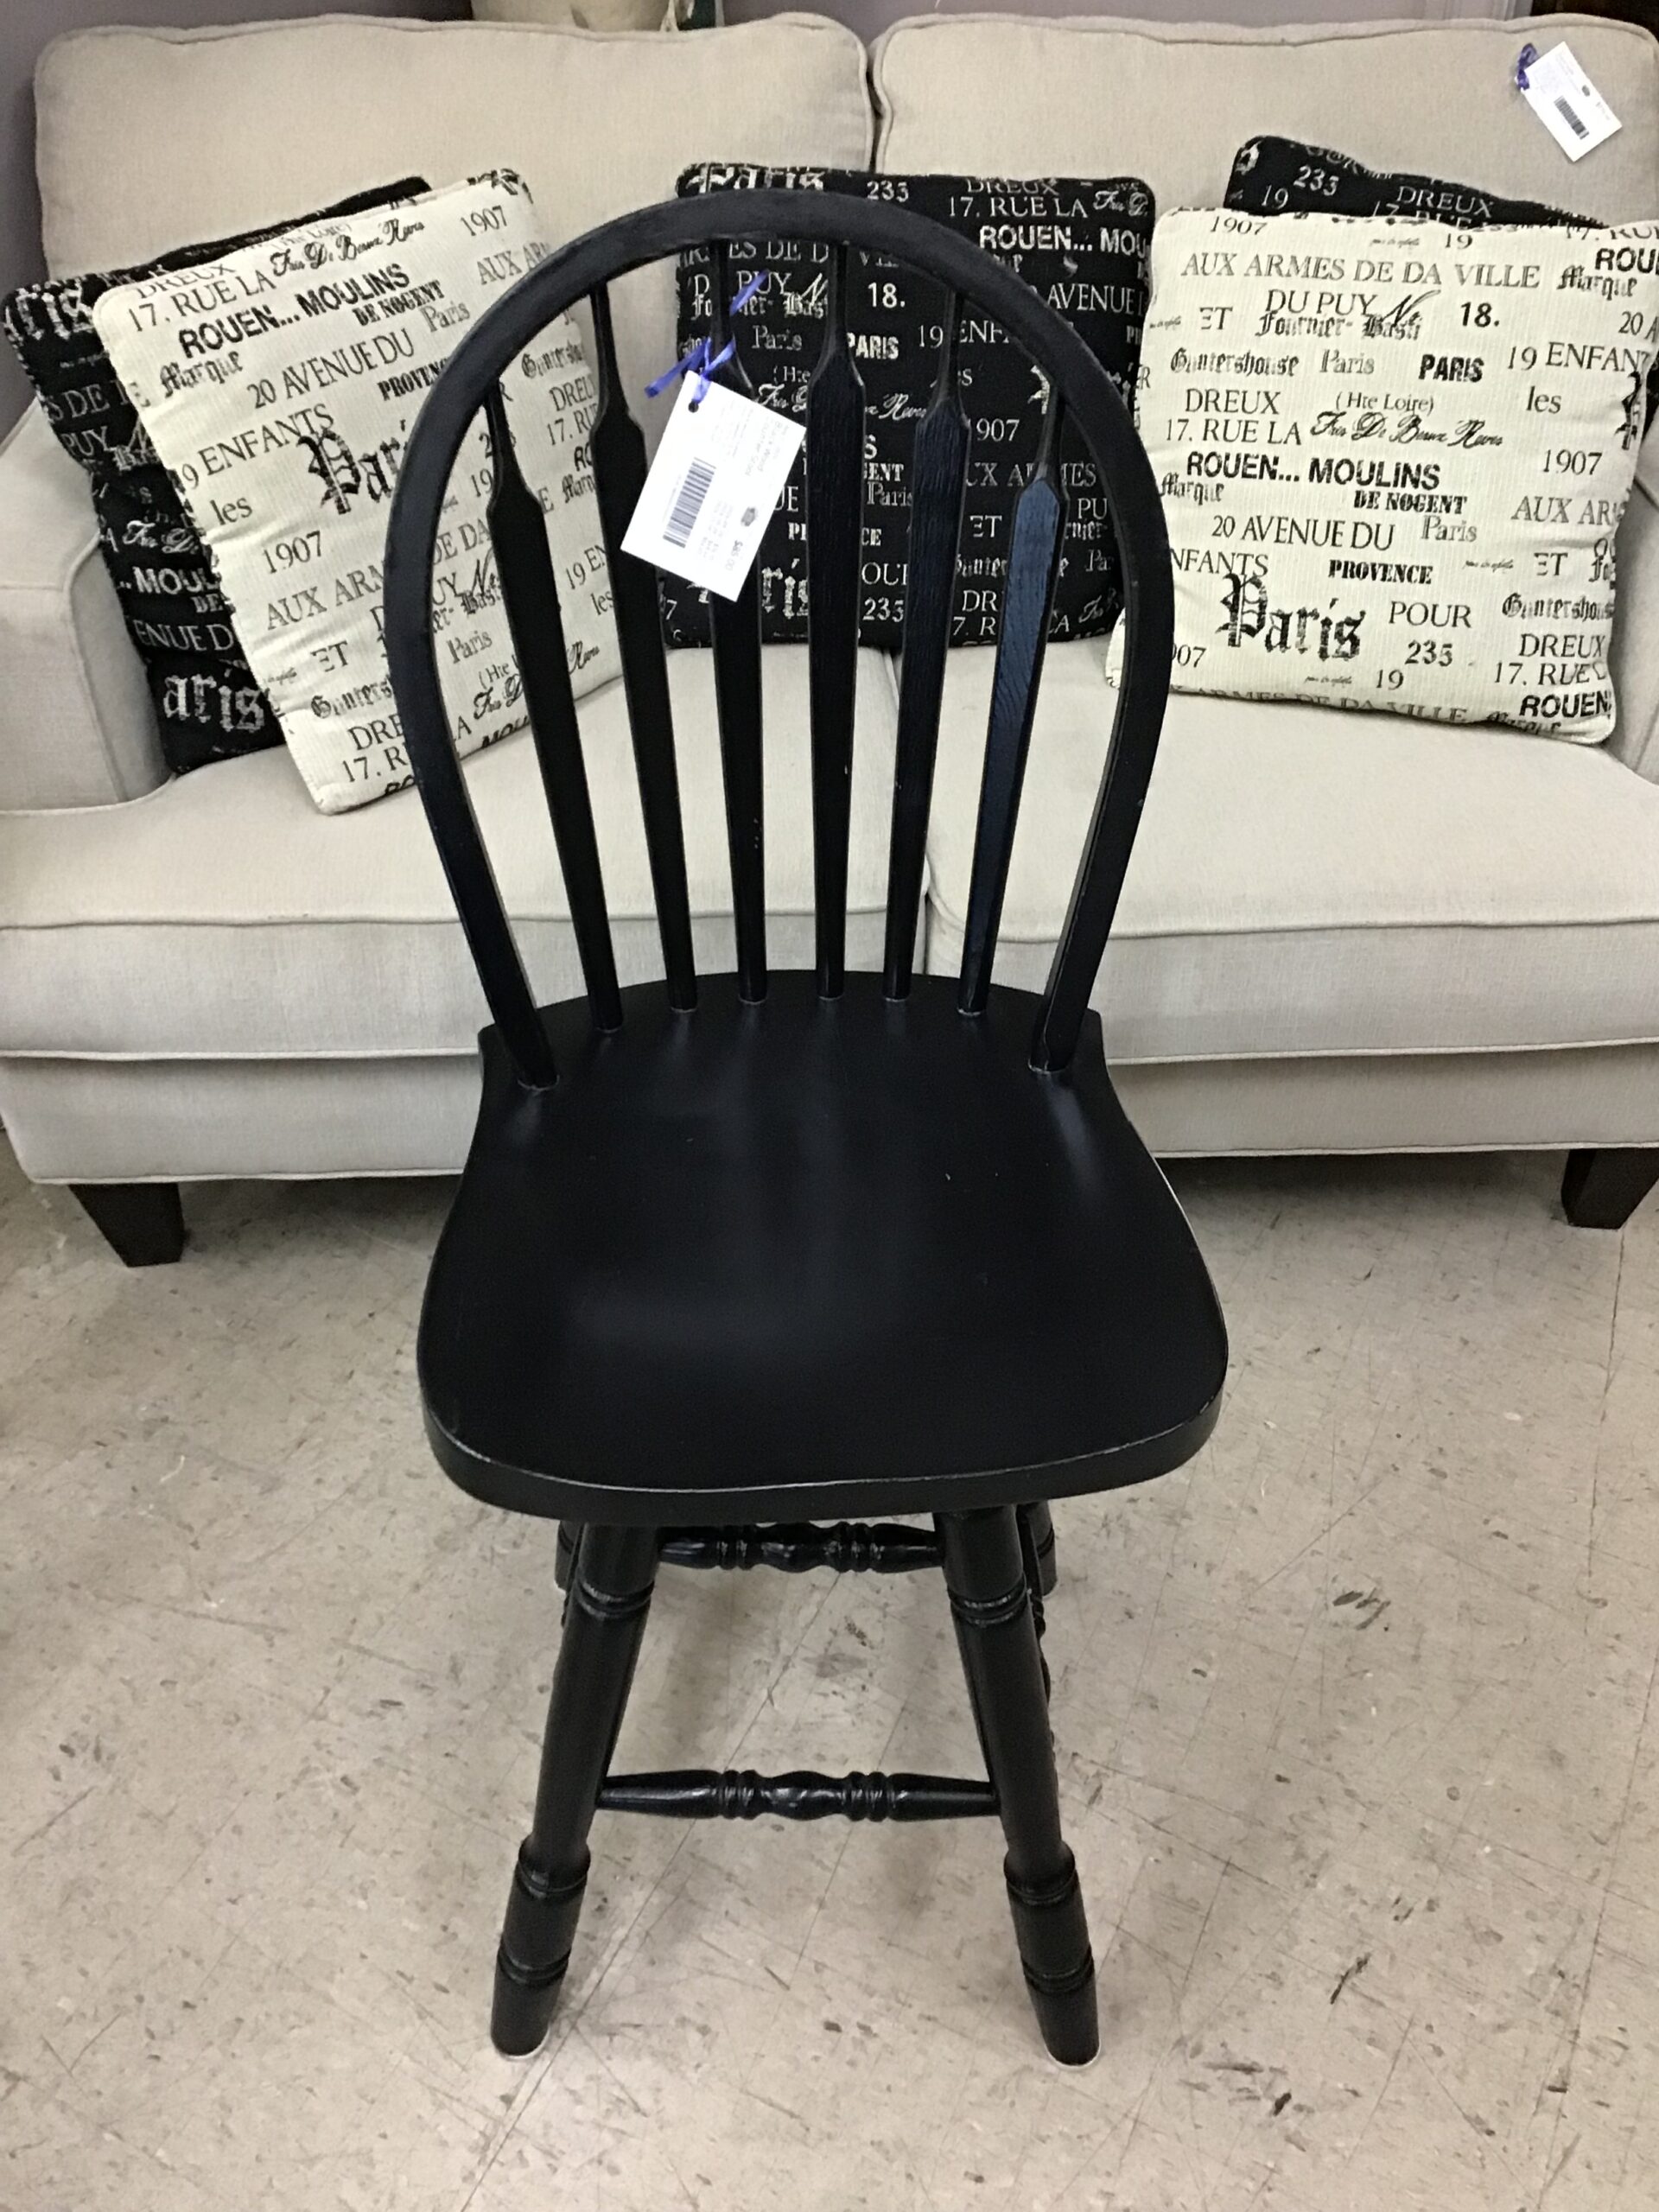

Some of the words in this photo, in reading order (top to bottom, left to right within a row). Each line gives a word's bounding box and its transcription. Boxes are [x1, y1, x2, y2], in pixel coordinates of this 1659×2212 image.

[950, 196, 981, 218] 17.
[990, 196, 1047, 218] RUE
[1055, 199, 1089, 219] LA
[1261, 184, 1289, 210] 19
[1396, 186, 1494, 218] DREUX
[461, 204, 509, 237] 1907
[1210, 215, 1268, 236] 1907
[979, 225, 1092, 251] ROUEN...
[1445, 233, 1473, 249] 19
[476, 250, 524, 286] AUX
[1180, 252, 1238, 277] AUX
[1243, 252, 1346, 282] ARMES
[1352, 259, 1395, 283] DE
[1402, 261, 1442, 286] DA
[1454, 263, 1541, 289] VILLE
[1595, 246, 1659, 276] ROUE
[137, 262, 236, 300] DREUX
[868, 282, 906, 308] 18.
[128, 302, 171, 333] 17.
[170, 286, 238, 318] RUE
[235, 270, 277, 301] LA
[178, 302, 301, 359] ROUEN...
[295, 263, 410, 317] MOULINS
[352, 305, 382, 327] DE
[378, 279, 446, 320] NOGENT
[1264, 289, 1312, 313] DU
[1316, 291, 1378, 317] PUY
[1459, 302, 1500, 327] 18.
[420, 301, 472, 333] Paris
[1199, 306, 1234, 330] ET
[1618, 311, 1643, 334] 20
[847, 332, 899, 360] PARIS
[917, 325, 944, 348] 19
[1319, 348, 1375, 374] Paris
[1418, 354, 1484, 383] PARIS
[1507, 346, 1537, 371] 19
[1545, 341, 1651, 372] ENFANT
[377, 356, 449, 402] PROVENC
[548, 375, 598, 412] DREU
[63, 382, 111, 419] DE
[247, 378, 277, 410] 20
[1185, 389, 1281, 416] DREUX
[1526, 385, 1562, 414] les
[547, 416, 574, 446] 17.
[1166, 419, 1192, 442] 17.
[1203, 419, 1258, 443] RUE
[1267, 423, 1302, 446] LA
[180, 462, 200, 490] 9
[197, 403, 335, 478] ENFANTS
[864, 462, 905, 482] ENT
[1186, 451, 1300, 482] ROUEN...
[1308, 457, 1441, 491] MOULINS
[1542, 448, 1603, 476] 1907
[470, 468, 495, 499] 19
[210, 496, 253, 527] les
[1078, 498, 1108, 519] PU
[1354, 490, 1381, 510] DE
[1385, 493, 1468, 514] NOGENT
[1511, 495, 1573, 524] AUX
[969, 514, 1002, 538] ET
[1211, 515, 1236, 538] 20
[1241, 515, 1346, 548] AVENUE
[1350, 521, 1395, 551] DU
[1421, 516, 1478, 543] Paris
[262, 530, 323, 575] 1907
[1169, 548, 1268, 577] NFANTS
[1534, 552, 1568, 576] ET
[565, 562, 586, 590] 19
[1328, 559, 1433, 585] PROVENCE
[266, 586, 328, 632] AUX
[863, 597, 906, 623] 235
[1215, 572, 1367, 663] Paris
[1388, 601, 1471, 628] POUR
[133, 619, 208, 652] ENUE
[207, 622, 235, 652] D
[445, 631, 493, 664] Paris
[1518, 632, 1606, 658] DREUX
[311, 640, 349, 673] ET
[1404, 639, 1453, 667] 235
[1376, 669, 1405, 690] 19
[1494, 662, 1528, 686] 17.
[1537, 663, 1590, 686] RUE
[162, 666, 266, 733] aris
[347, 714, 404, 752] DRE
[341, 755, 381, 784] 17.
